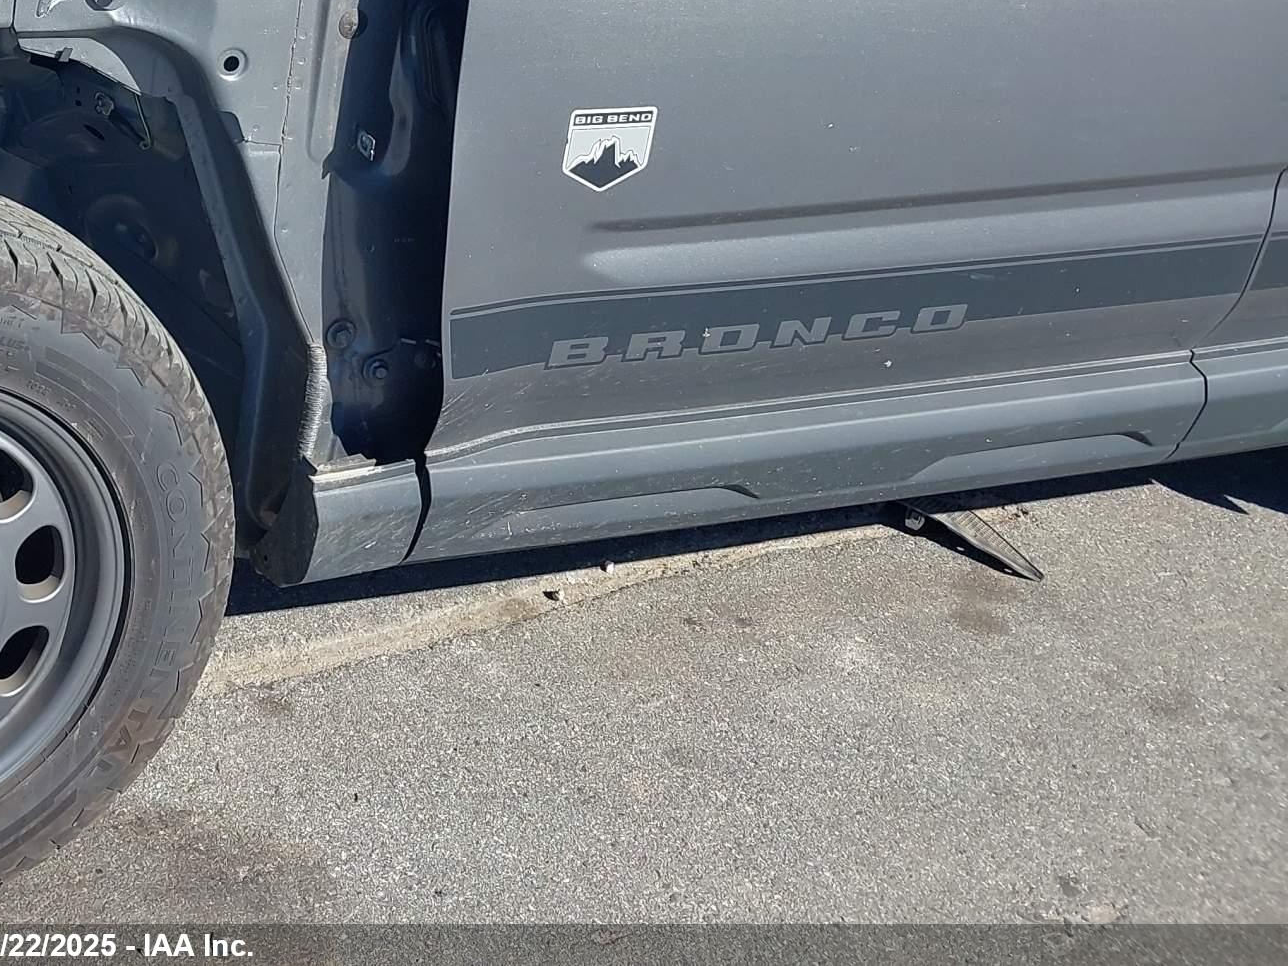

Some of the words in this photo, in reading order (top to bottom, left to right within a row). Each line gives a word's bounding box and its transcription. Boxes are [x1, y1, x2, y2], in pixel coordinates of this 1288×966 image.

[575, 115, 604, 125] BIG
[607, 112, 652, 123] BEND
[543, 304, 969, 370] BRONCO
